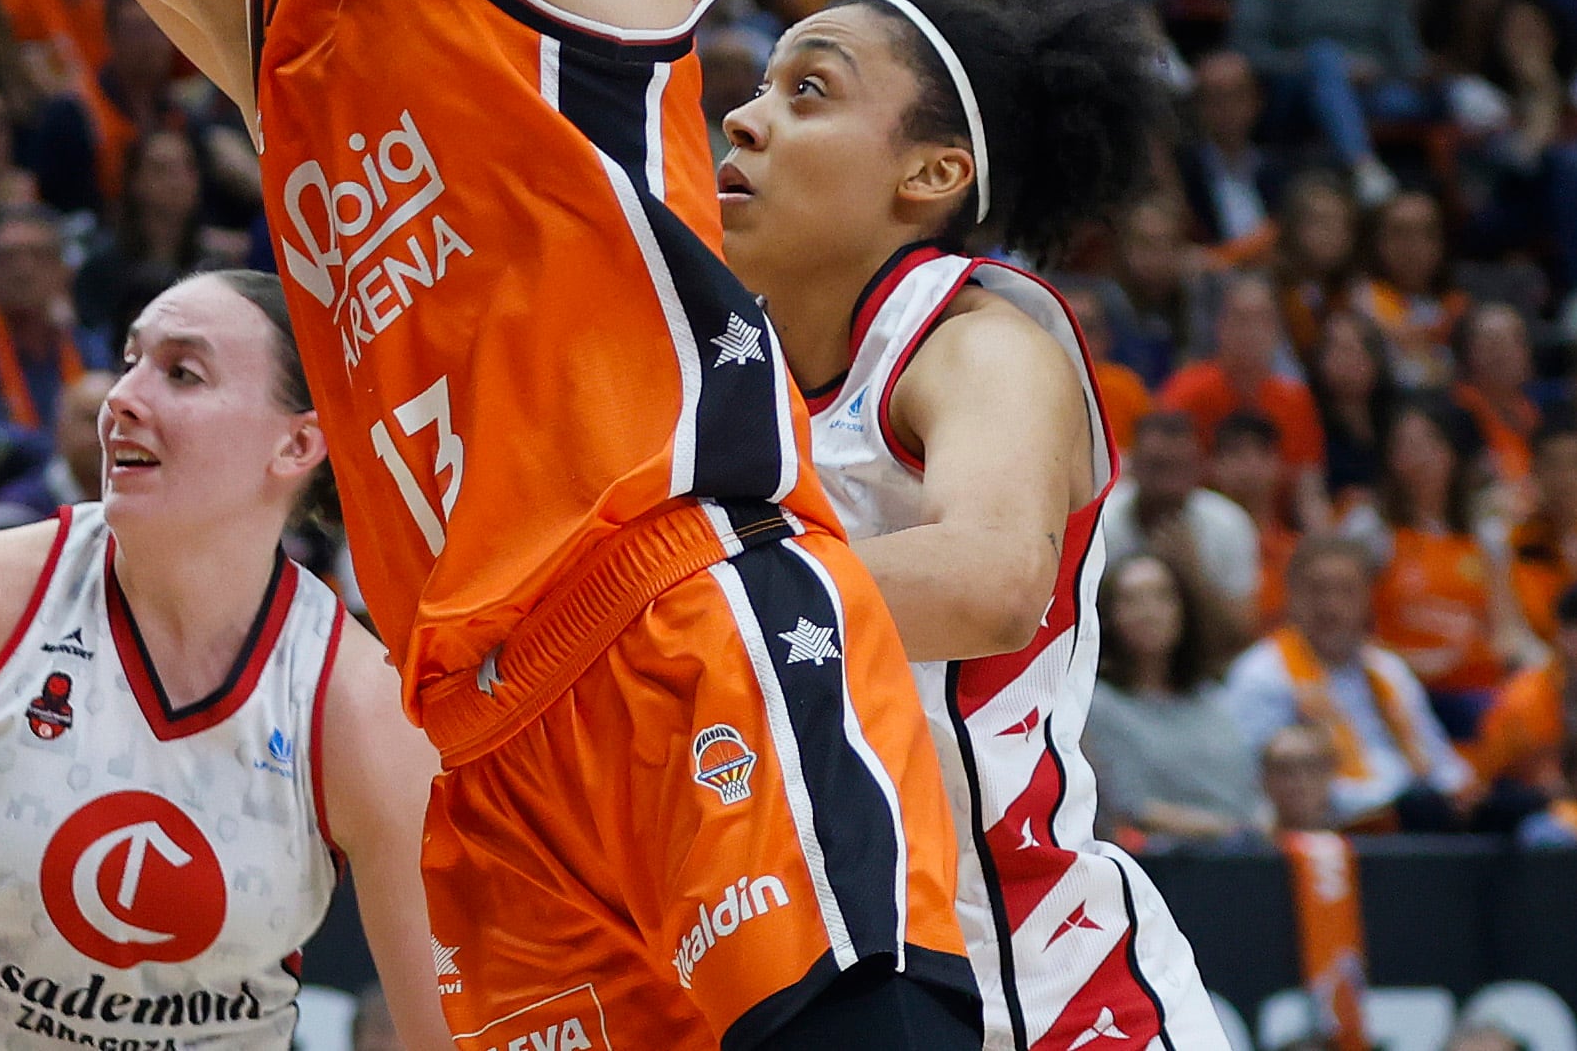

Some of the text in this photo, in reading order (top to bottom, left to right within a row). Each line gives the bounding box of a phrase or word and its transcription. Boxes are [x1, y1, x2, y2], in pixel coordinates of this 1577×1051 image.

[281, 108, 446, 325] Roig
[340, 215, 474, 386] ARENA
[369, 374, 464, 559] 13
[487, 1017, 593, 1051] EVA
